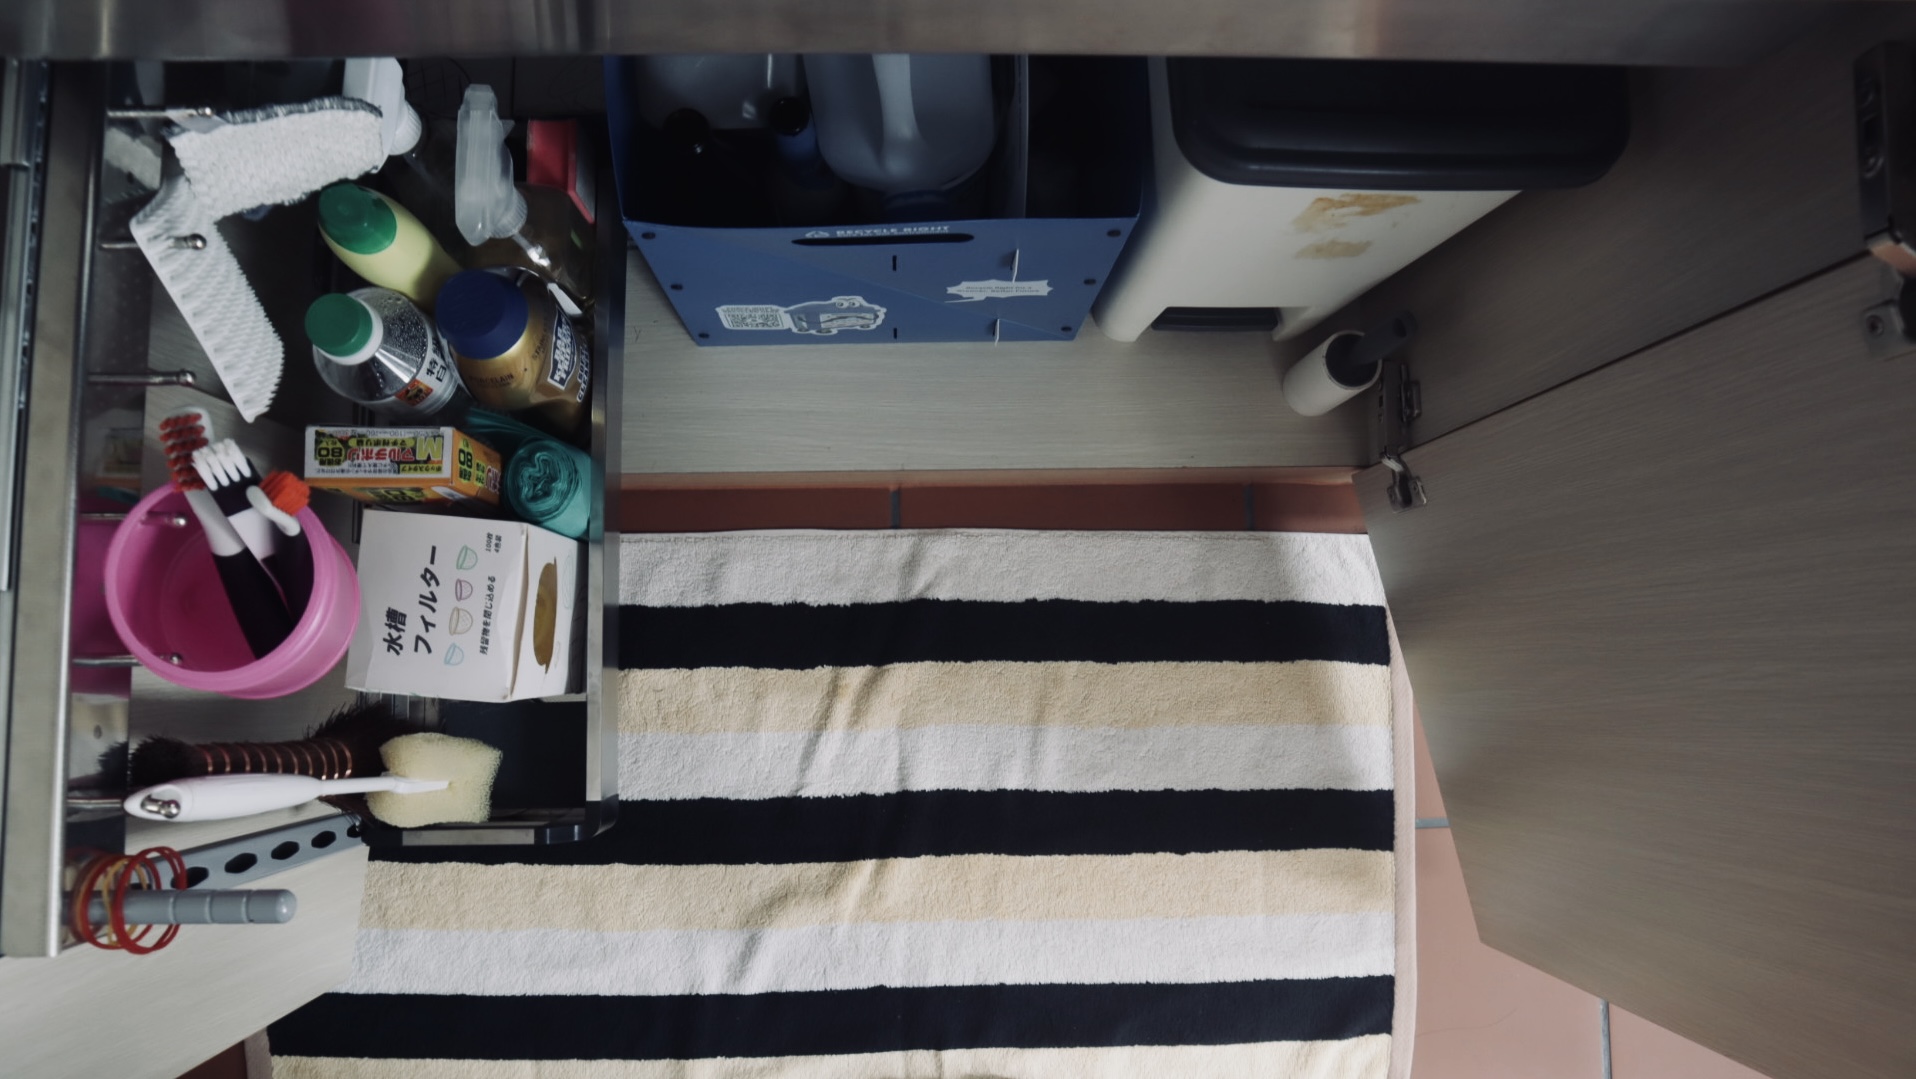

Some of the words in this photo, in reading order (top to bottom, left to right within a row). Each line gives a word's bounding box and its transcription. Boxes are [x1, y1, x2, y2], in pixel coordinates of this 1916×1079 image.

[836, 228, 894, 236] RECYCLE
[903, 225, 949, 233] RIGHT
[554, 326, 563, 361] BAR
[560, 324, 571, 380] FRIEND
[577, 347, 586, 383] SOFT
[317, 447, 343, 457] 80
[347, 448, 415, 462] マルチポリ
[416, 436, 443, 461] M
[458, 447, 473, 468] 80
[401, 465, 442, 473] ボックスタイプ
[485, 532, 493, 552] 100枚
[414, 545, 440, 654] フィルター
[480, 575, 496, 655] 残留物を閉じ込める
[382, 607, 407, 656] 水槽
